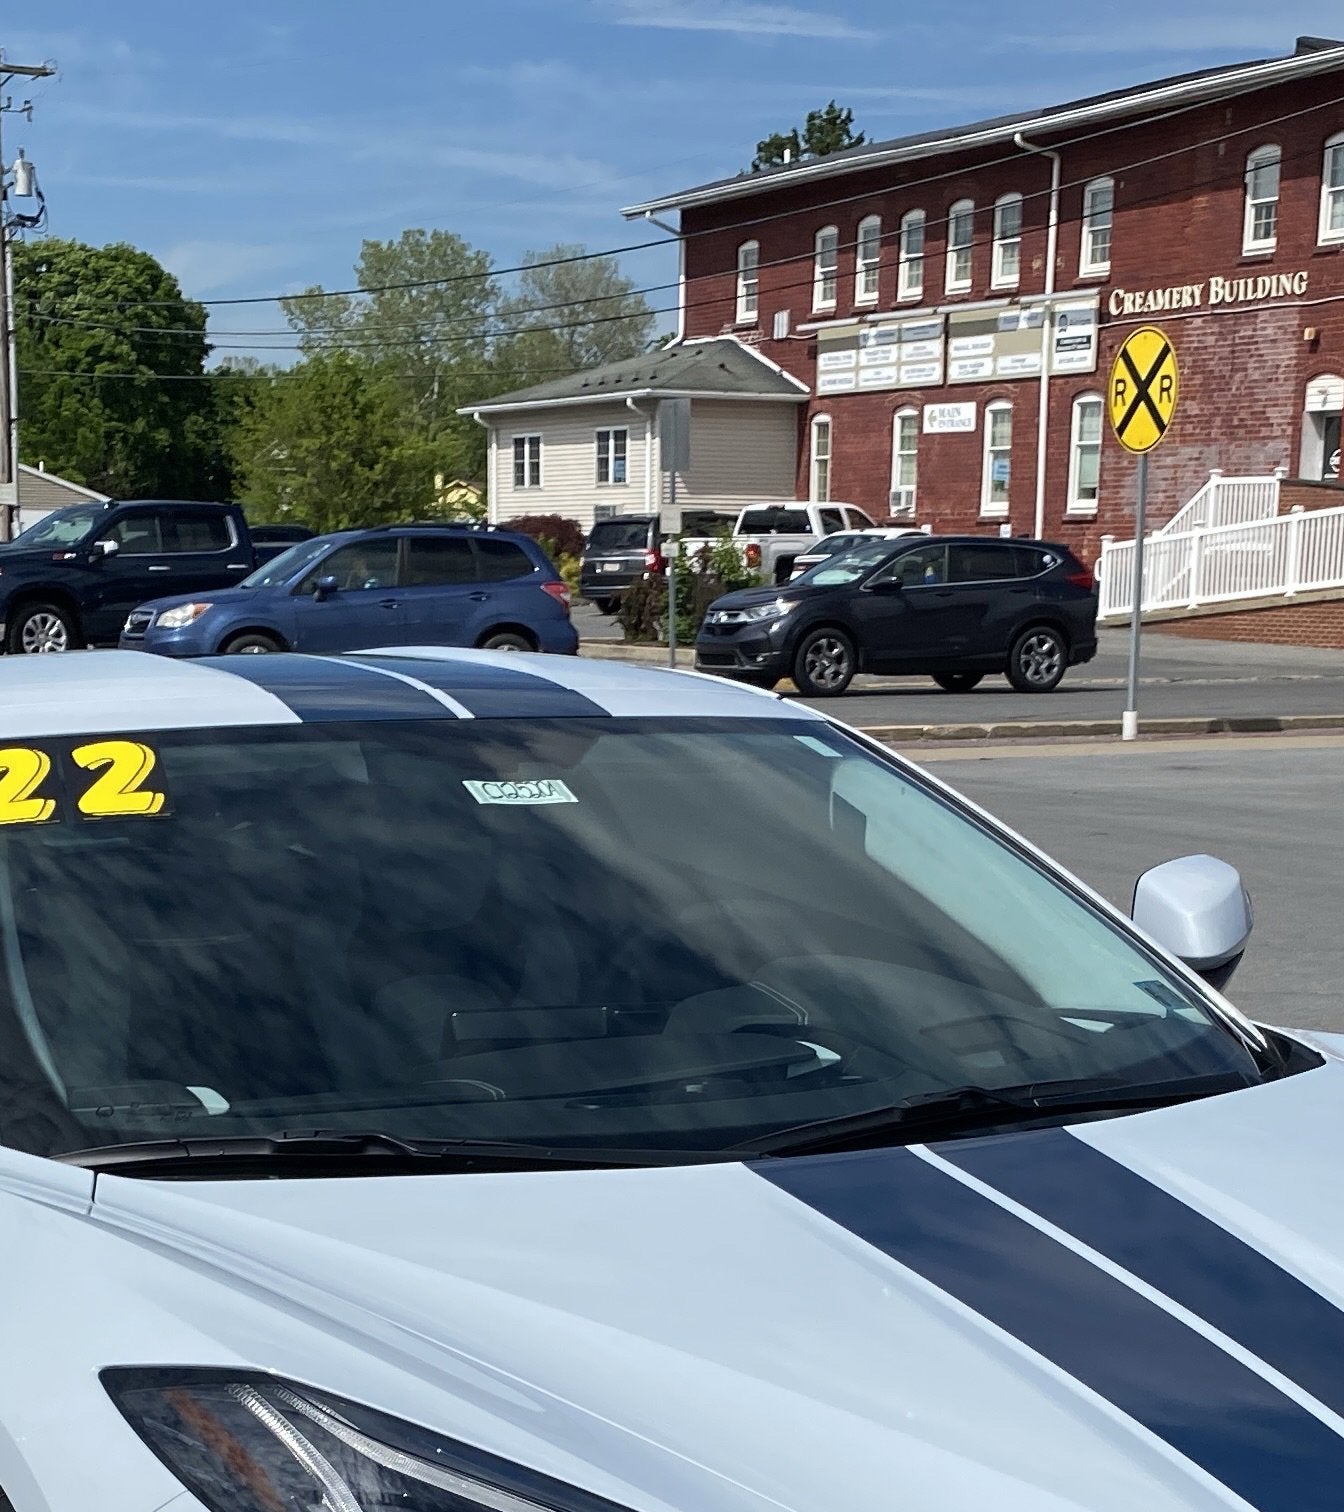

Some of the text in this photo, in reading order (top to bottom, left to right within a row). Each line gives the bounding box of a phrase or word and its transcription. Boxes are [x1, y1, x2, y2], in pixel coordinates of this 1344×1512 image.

[1108, 272, 1308, 315] CREAMERY BUILDING
[1114, 374, 1173, 407] R R
[938, 406, 961, 419] MAIN
